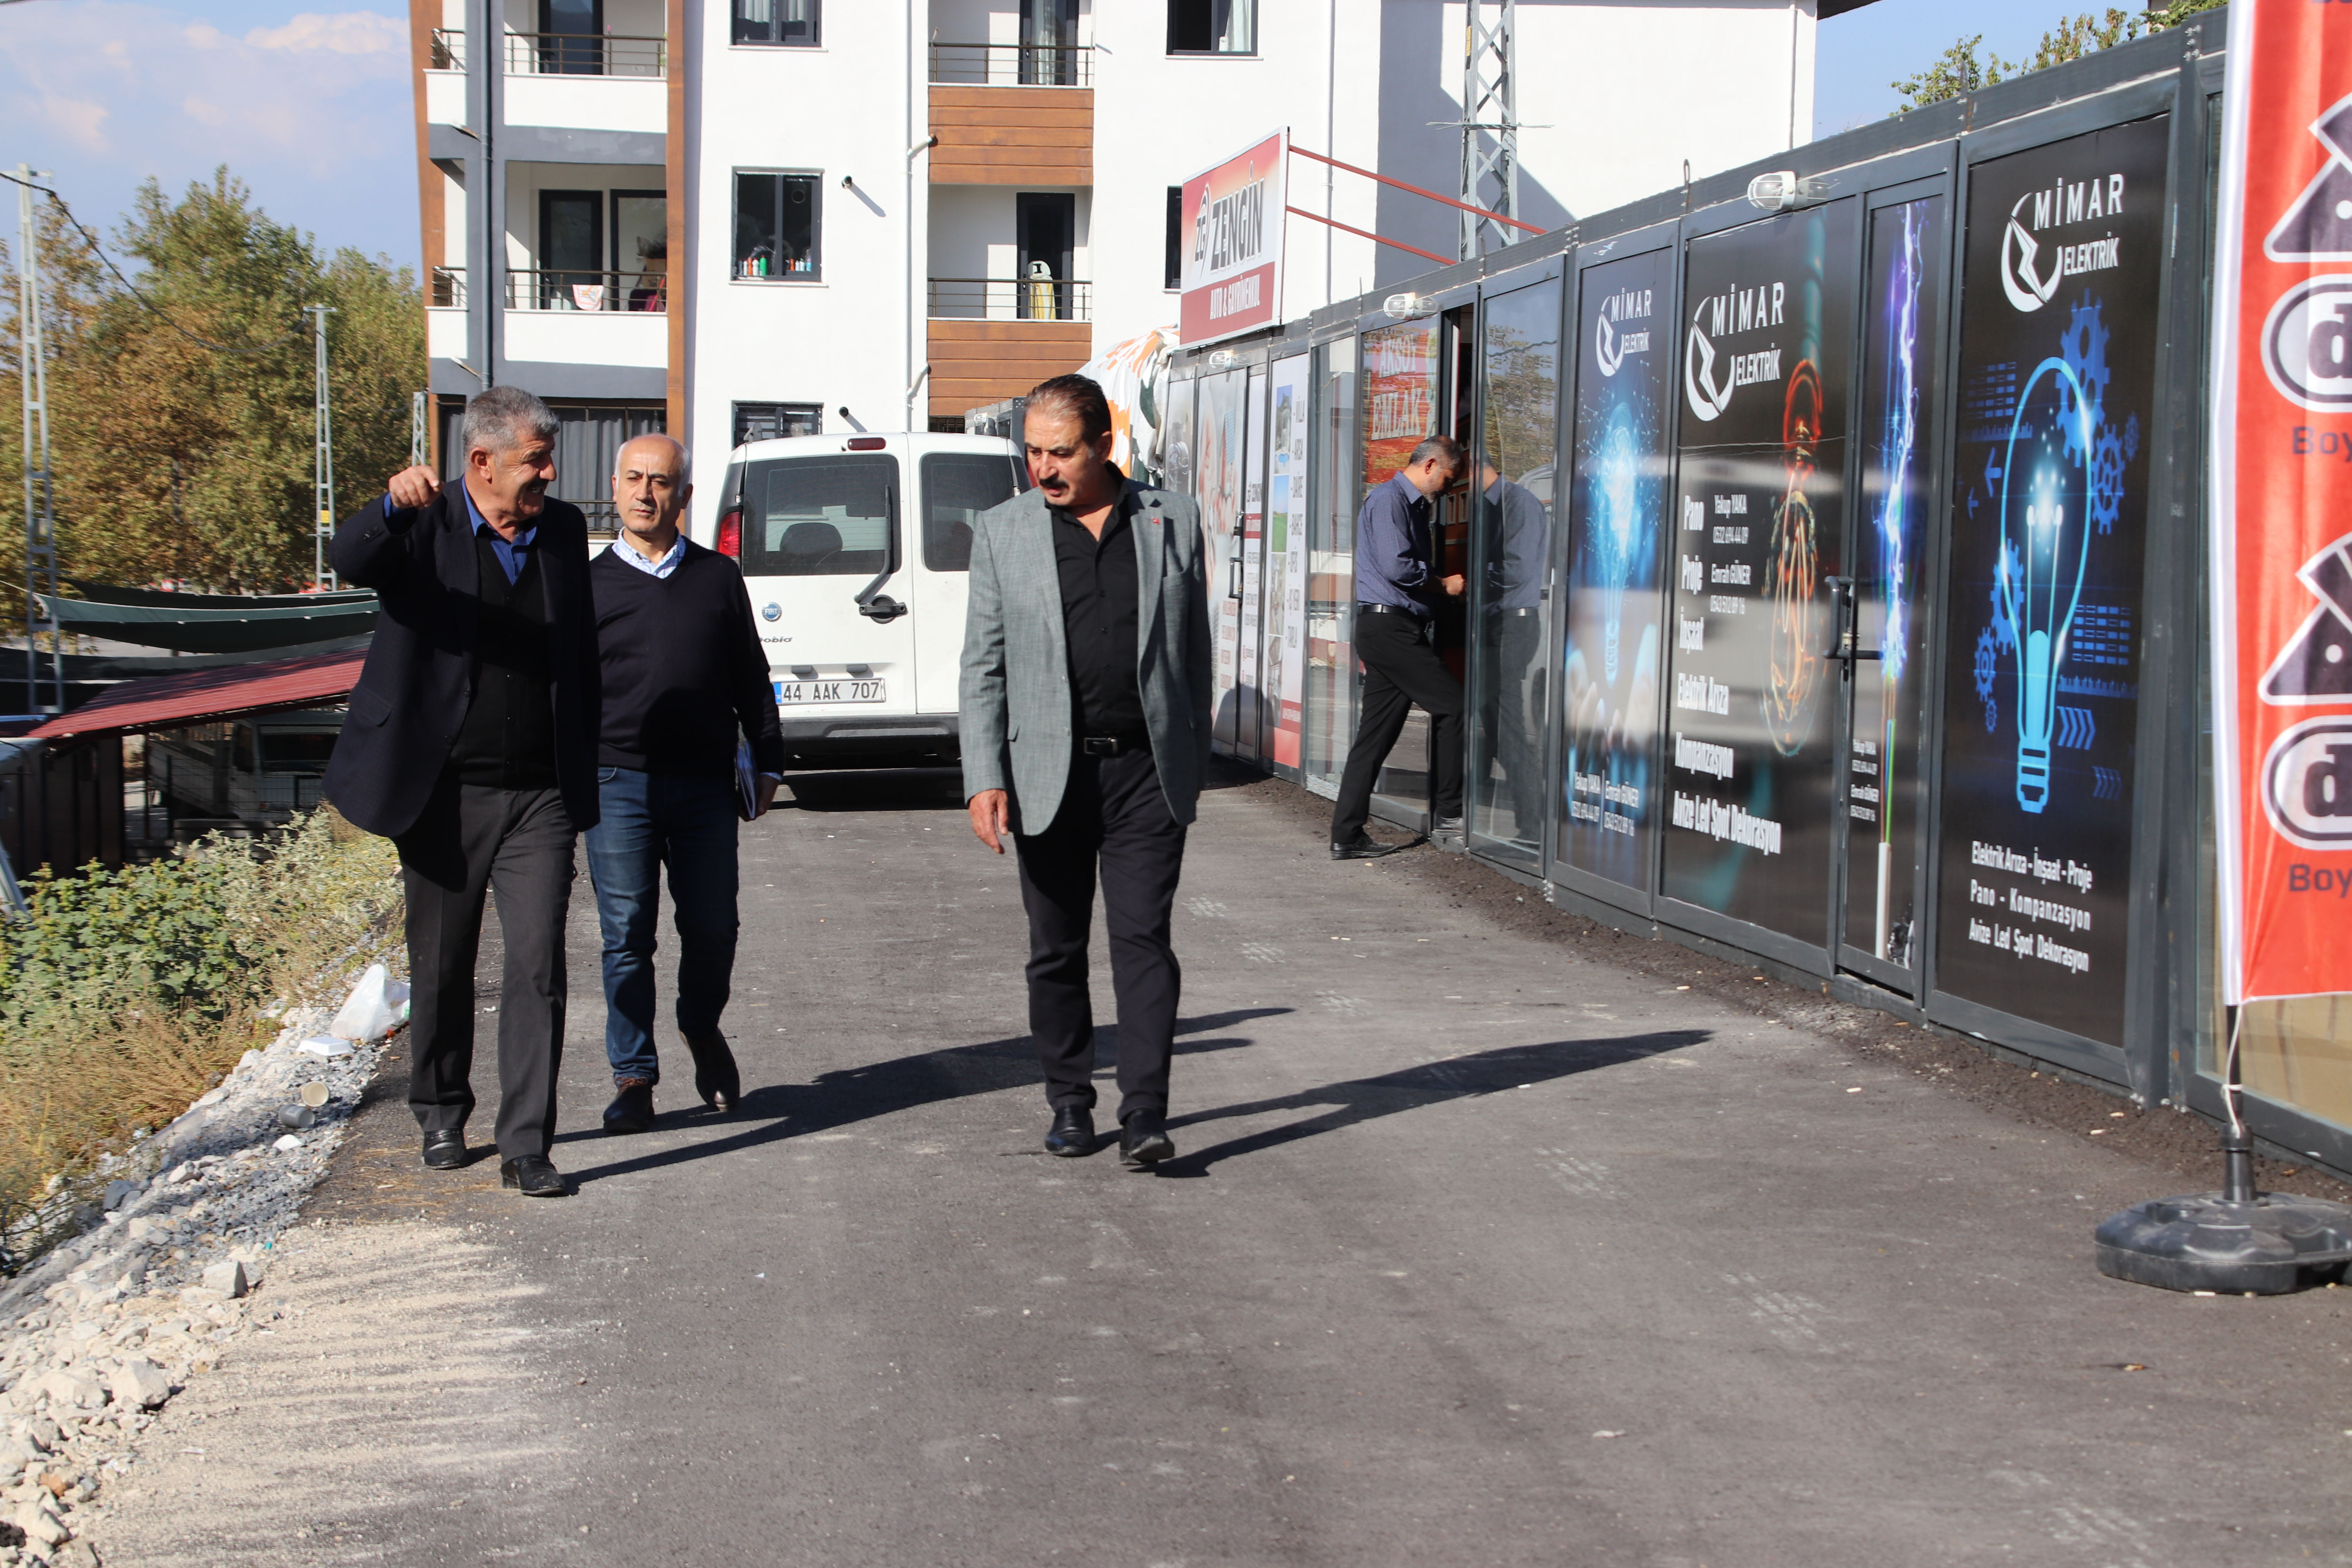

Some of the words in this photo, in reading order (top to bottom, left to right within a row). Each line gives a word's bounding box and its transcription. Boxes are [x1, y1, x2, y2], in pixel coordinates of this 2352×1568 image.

[1210, 160, 1265, 273] ZENGİN
[2033, 174, 2124, 230] MİMAR
[2063, 231, 2120, 276] ELEKTRİK
[1210, 287, 1222, 320] AUTO
[1223, 287, 1228, 317] &
[1228, 274, 1261, 316] GAYRİMENKUL
[1611, 287, 1652, 322] MİMAR
[1711, 282, 1785, 337] MİMAR
[1379, 333, 1417, 379] AKSOY
[1624, 327, 1650, 354] ELEKTRİK
[1736, 342, 1781, 386] ELEKTRİK
[1371, 387, 1422, 441] EMLAK
[1684, 495, 1704, 531] Pano
[1714, 495, 1731, 519] Yakup
[1731, 494, 1748, 514] YAKA
[1713, 526, 1725, 544] 0532
[1681, 554, 1703, 595] Proje
[1711, 563, 1730, 583] Emrah
[1730, 559, 1751, 585] GÜNER
[1679, 606, 1704, 654] İnşaat
[784, 684, 802, 701] 44
[813, 683, 841, 700] AAK
[851, 682, 879, 699] 707
[1677, 672, 1708, 711] Elektrik
[1708, 676, 1730, 716] Arıza
[1675, 731, 1733, 780] Kompanzasyon
[1587, 773, 1601, 794] YAKA
[1605, 780, 1621, 803] Emrah
[1621, 780, 1639, 809] GÜNER
[1672, 790, 1694, 829] Avize
[1694, 795, 1711, 834] Led
[1711, 799, 1730, 841] Spot
[1730, 804, 1781, 856] Dekorasyon
[1972, 840, 2005, 870] Elektrik
[2005, 847, 2027, 874] Arıza
[2033, 847, 2061, 885] İnşaat
[2067, 860, 2092, 894] Proje
[2289, 863, 2352, 898] Boy
[1970, 879, 1995, 907] Pano
[2010, 887, 2091, 933] Kompanzasyon
[1969, 917, 1991, 944] Avize
[1994, 923, 2011, 950] Led
[2013, 928, 2034, 959] Spot
[2037, 934, 2089, 974] Dekorasyon
